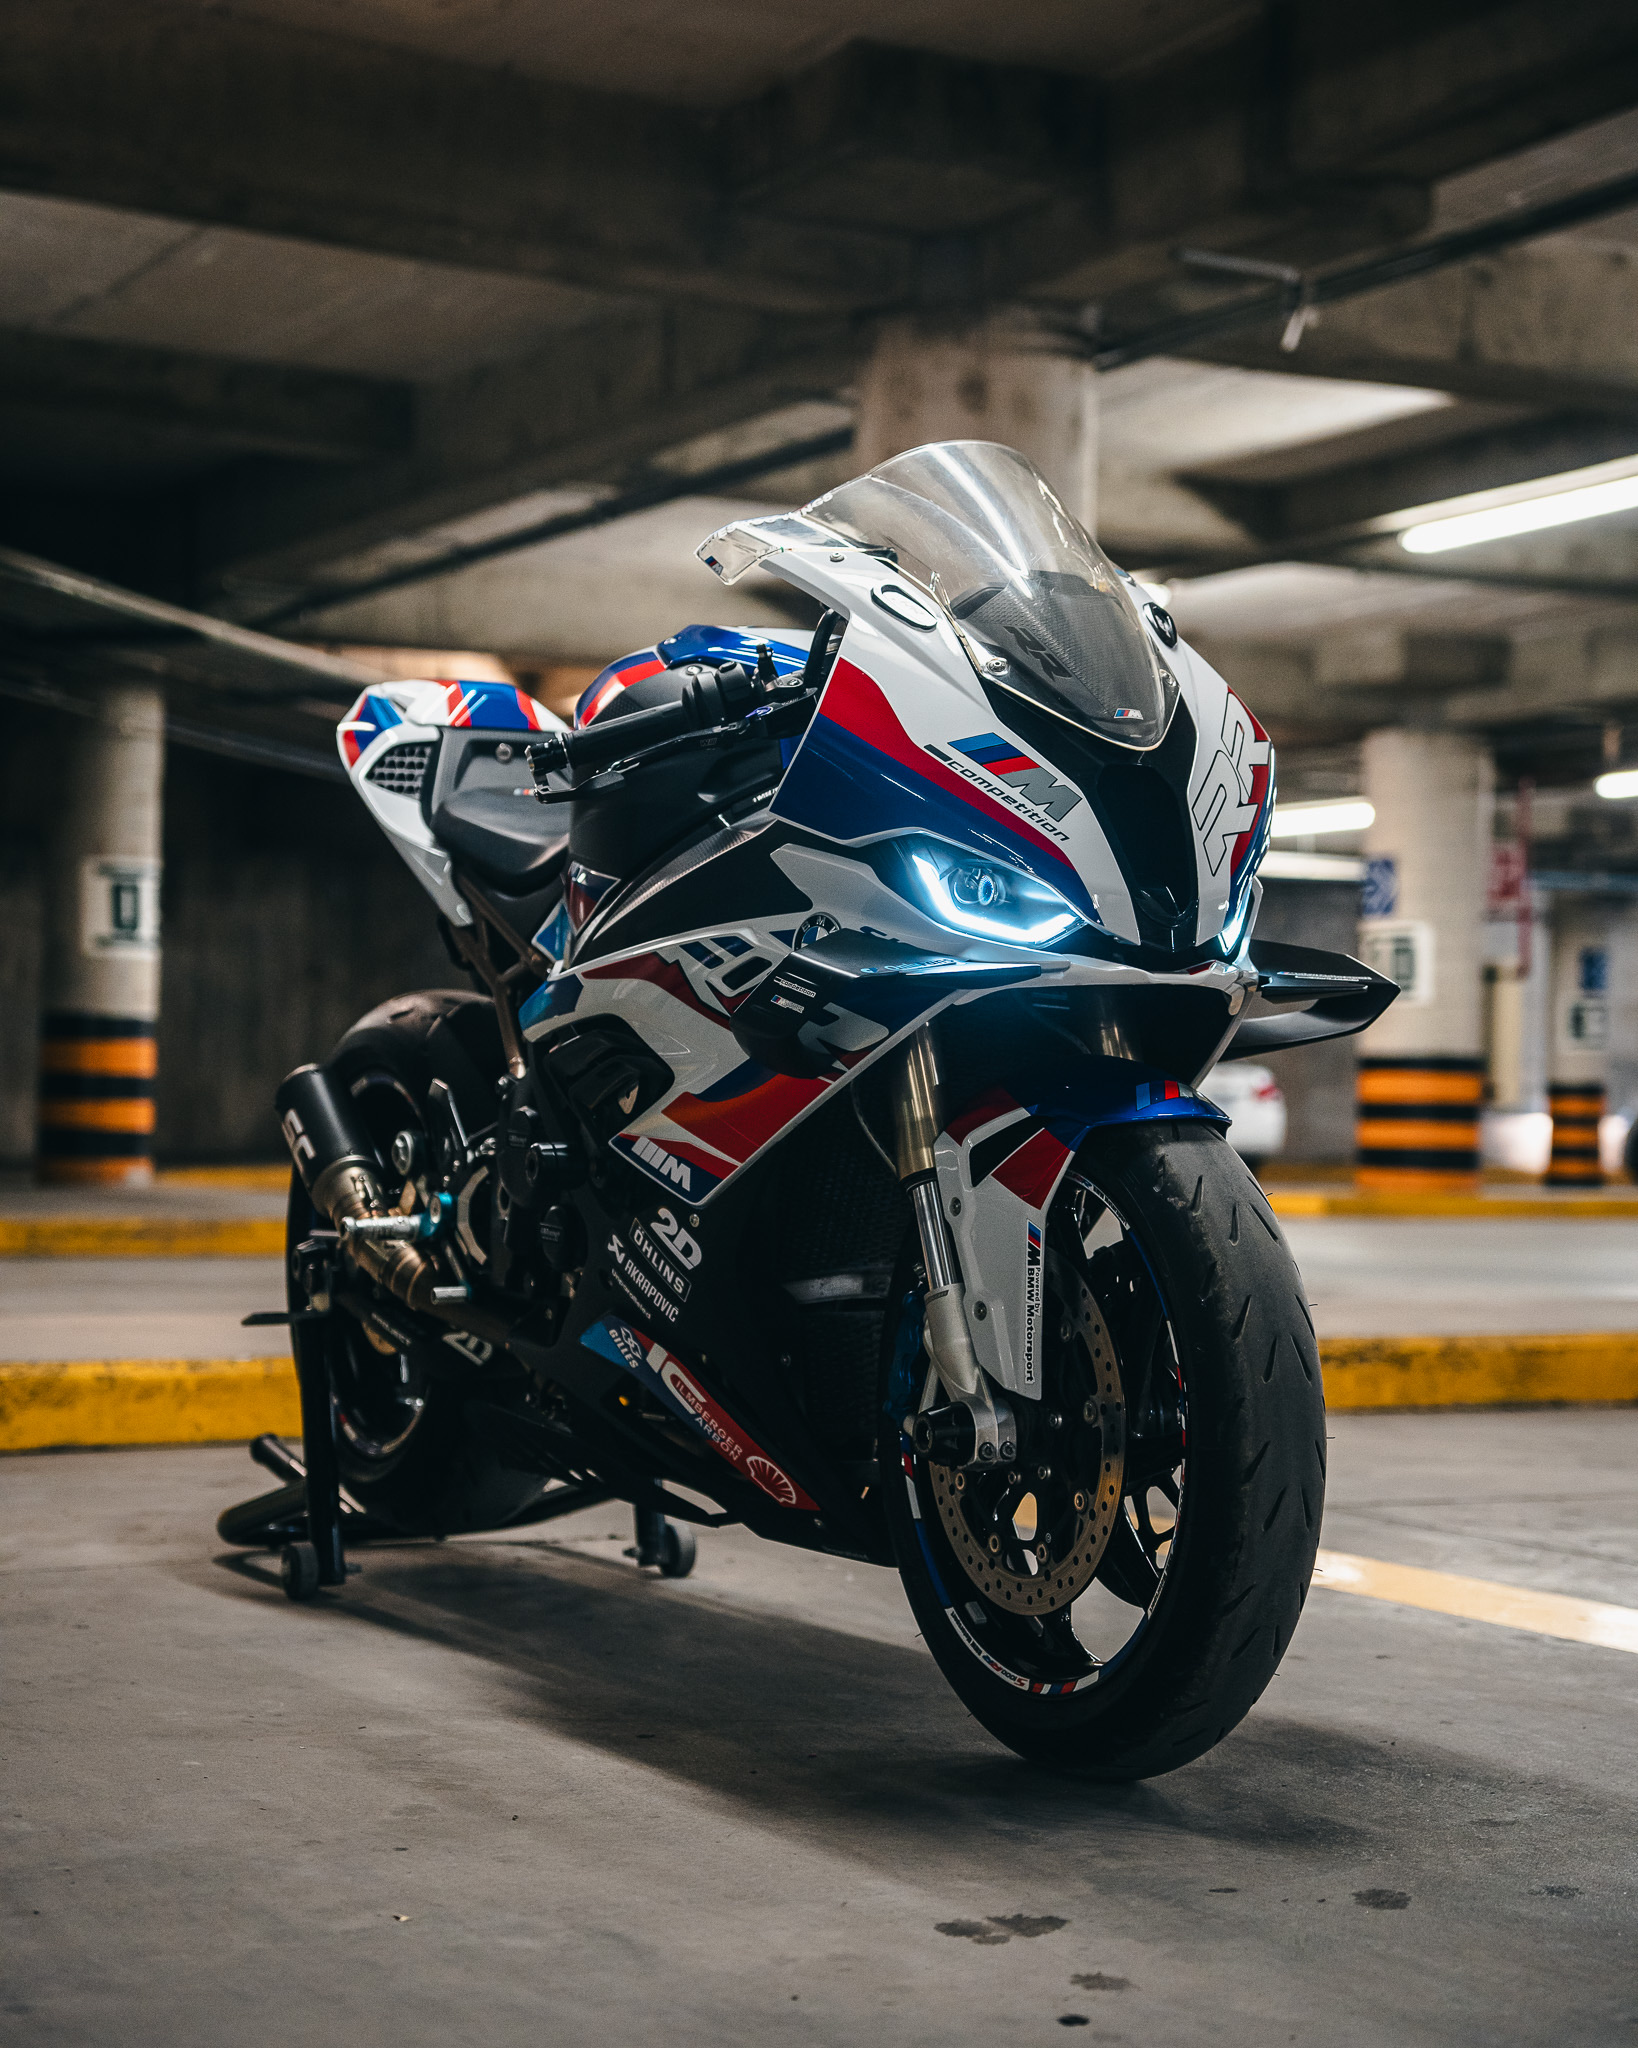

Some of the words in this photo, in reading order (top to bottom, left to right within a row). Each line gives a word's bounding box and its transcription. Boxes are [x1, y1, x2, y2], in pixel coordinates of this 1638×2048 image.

[946, 758, 1070, 842] competition
[633, 1226, 685, 1294] ÖHLINS
[650, 1207, 702, 1270] 2D
[624, 1258, 680, 1323] AKRAPOVIČ
[1026, 1267, 1035, 1302] BMW
[1034, 1302, 1041, 1314] by
[608, 1329, 639, 1369] GILLES
[1025, 1304, 1035, 1382] Motorsport
[675, 1380, 743, 1456] ILMBERGER
